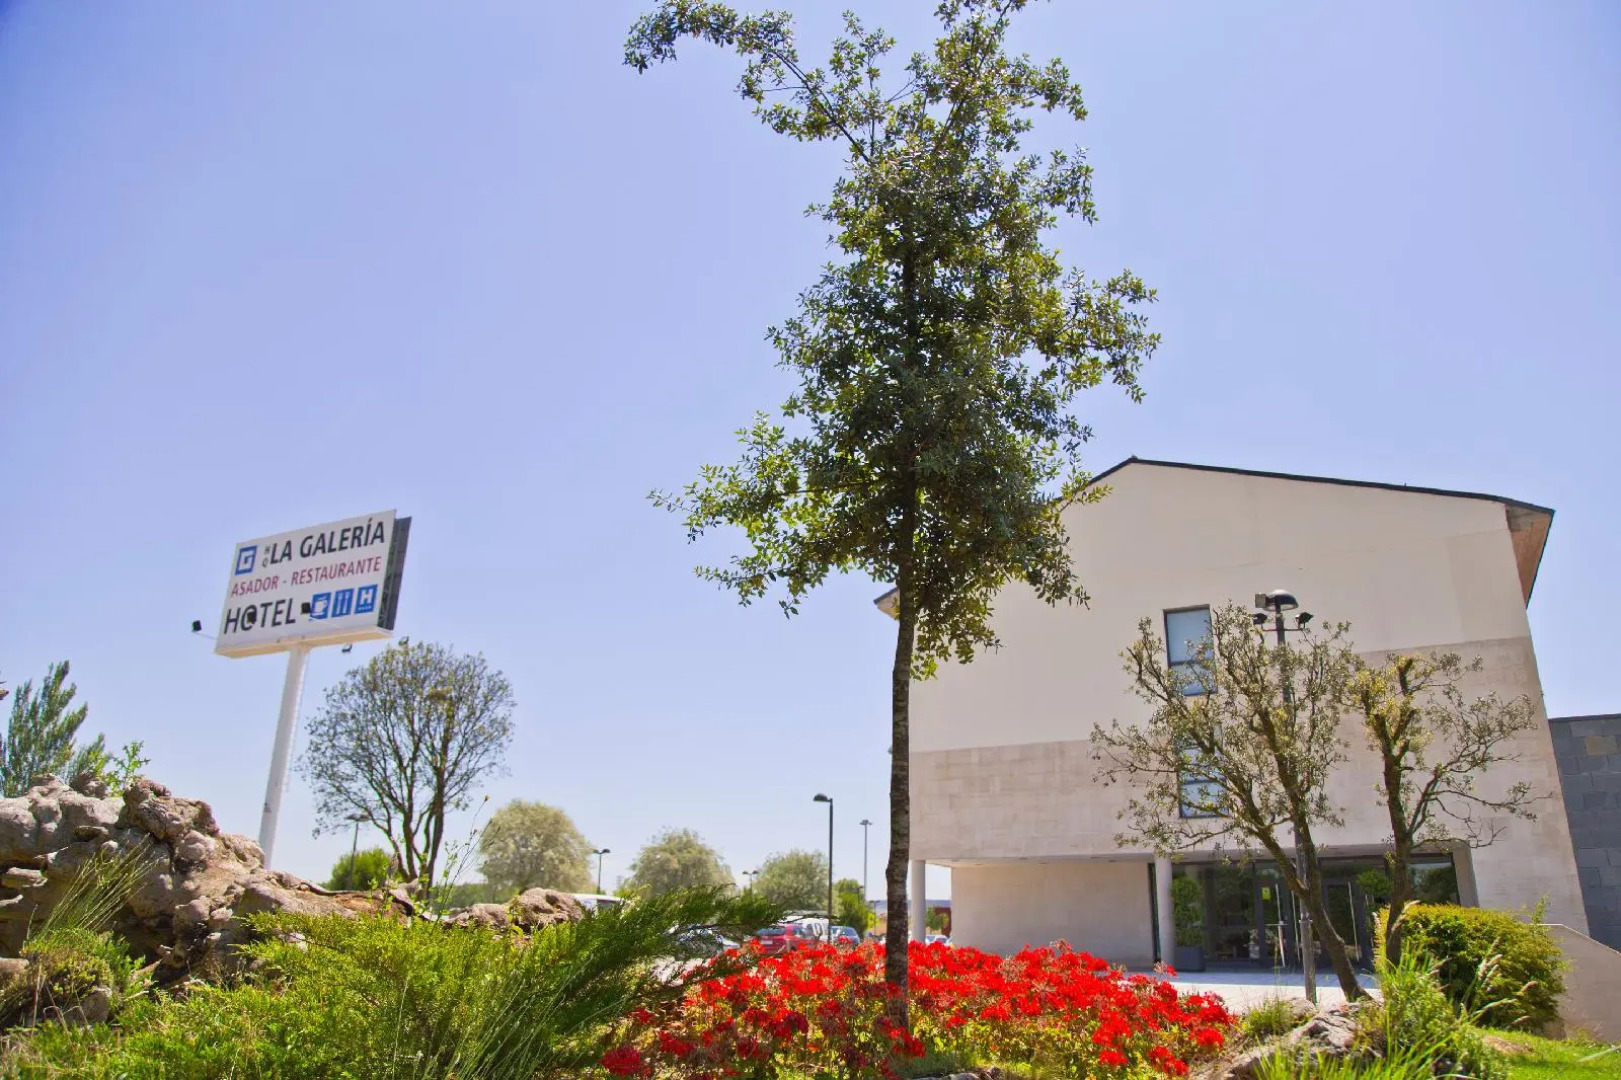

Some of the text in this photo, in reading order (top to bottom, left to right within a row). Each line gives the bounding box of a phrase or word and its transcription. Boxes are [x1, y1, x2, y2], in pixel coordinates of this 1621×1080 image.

[270, 518, 385, 564] LA GALERÍA
[231, 575, 279, 597] ASADOR
[291, 556, 382, 586] RESTAURANTE
[223, 598, 296, 634] HOTEL
